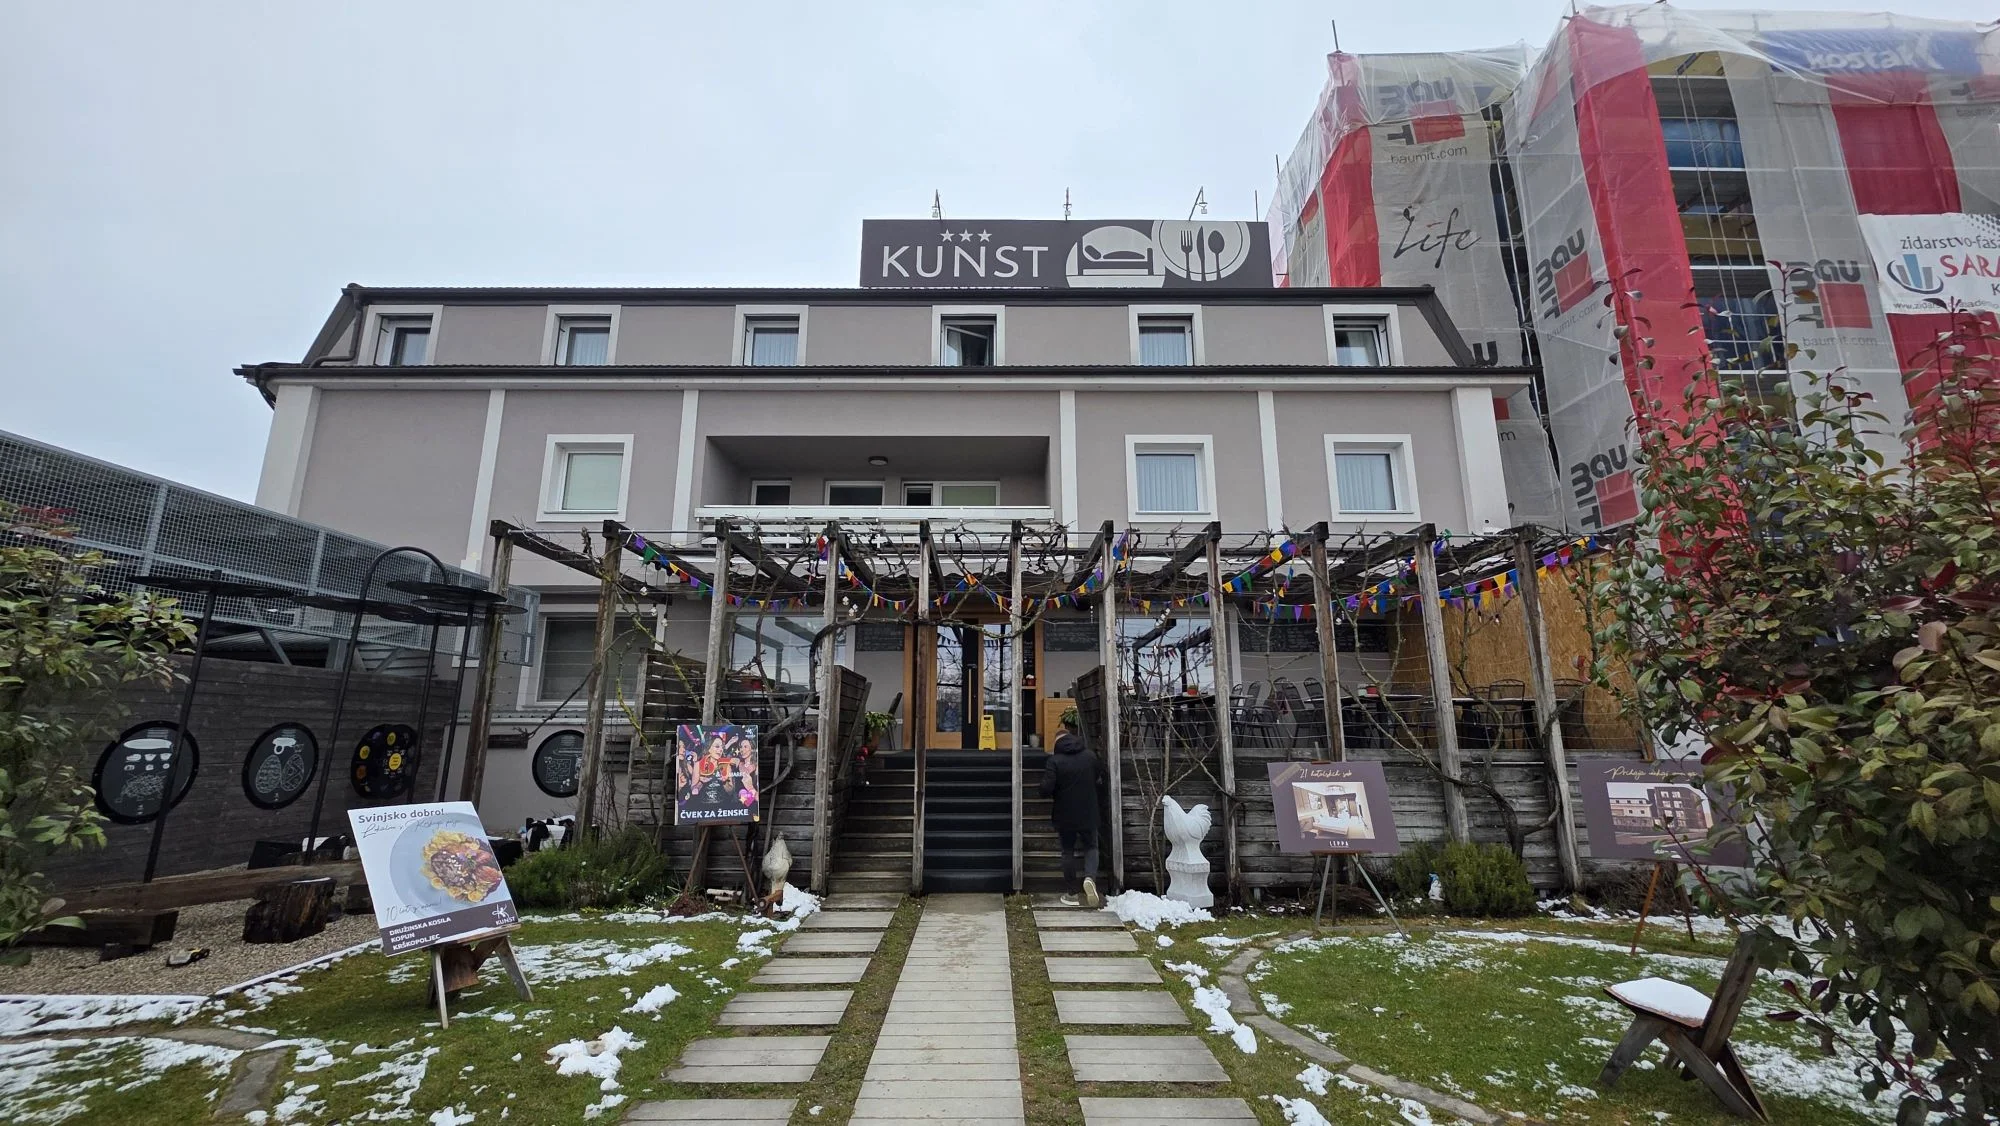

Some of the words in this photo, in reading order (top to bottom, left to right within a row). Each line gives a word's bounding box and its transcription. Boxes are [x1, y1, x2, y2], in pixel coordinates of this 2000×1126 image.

[882, 245, 1050, 278] KUNST
[1940, 253, 2000, 278] SAR
[358, 812, 407, 824] Svinjsko
[410, 808, 445, 818] dobro!
[680, 808, 703, 819] ČVEK
[704, 810, 716, 818] ZA
[717, 808, 749, 818] ŽENSKE
[389, 920, 428, 936] DRUŽINSKA
[428, 916, 452, 927] KOSILA
[495, 915, 516, 926] KUNST
[391, 932, 415, 943] KOPUN
[393, 933, 441, 951] KRŠKOPOLJEC
